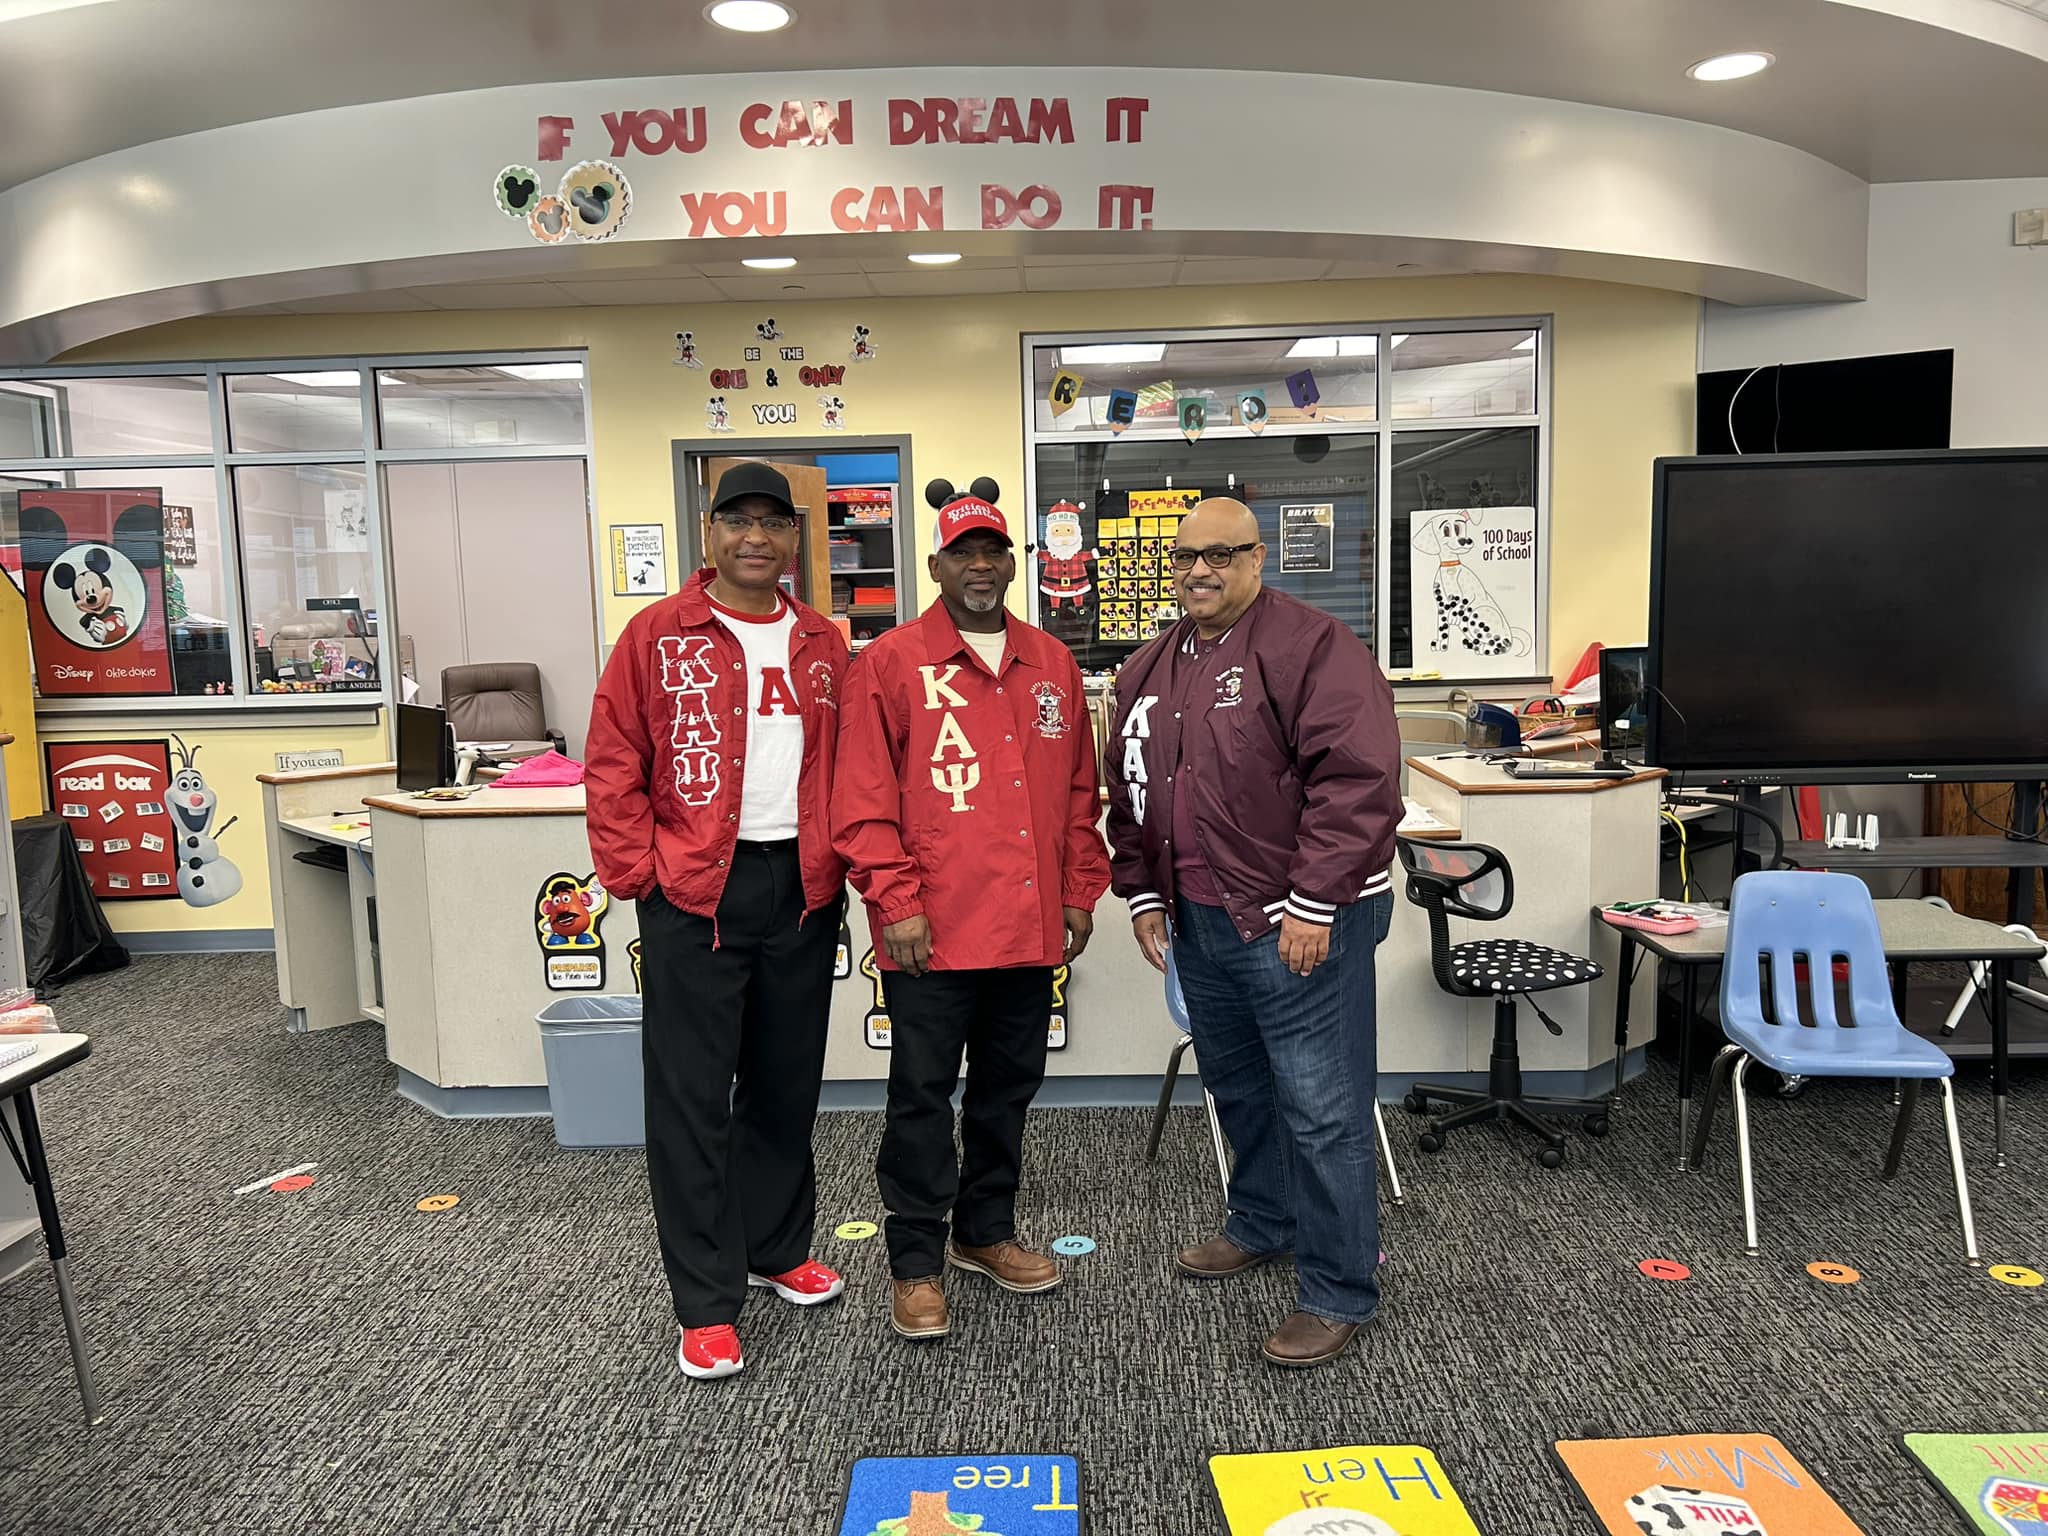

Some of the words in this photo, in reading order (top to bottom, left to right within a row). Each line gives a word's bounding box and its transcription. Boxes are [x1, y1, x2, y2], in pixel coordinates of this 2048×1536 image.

[601, 106, 707, 157] YOU
[739, 99, 853, 148] CAN
[888, 97, 1075, 145] DREAM
[1105, 97, 1149, 143] IT
[679, 191, 787, 237] YOU
[830, 185, 944, 233] CAN
[981, 184, 1062, 230] DO
[1098, 184, 1154, 231] IT!
[744, 347, 761, 361] BE
[780, 347, 804, 361] THE
[710, 368, 748, 389] ONE
[766, 368, 779, 387] &
[799, 364, 846, 388] ONLY
[752, 403, 796, 424] YOU!
[1129, 496, 1185, 512] DECEMBER
[1483, 529, 1503, 544] 100
[1507, 529, 1532, 545] Days
[628, 541, 659, 552] perfect
[1483, 549, 1493, 560] of
[1497, 546, 1531, 559] School
[660, 657, 712, 669] Kappa
[279, 756, 290, 768] If
[291, 760, 316, 770] you
[318, 758, 340, 766] can
[60, 772, 104, 791] read
[114, 771, 152, 791] box
[845, 1226, 867, 1234] 4
[1063, 1240, 1084, 1249] 5
[1653, 1264, 1676, 1273] 7
[1820, 1268, 1843, 1277] 8
[1643, 1447, 1801, 1488] Milk
[1303, 1457, 1443, 1500] Hen
[953, 1465, 1078, 1511] Tree
